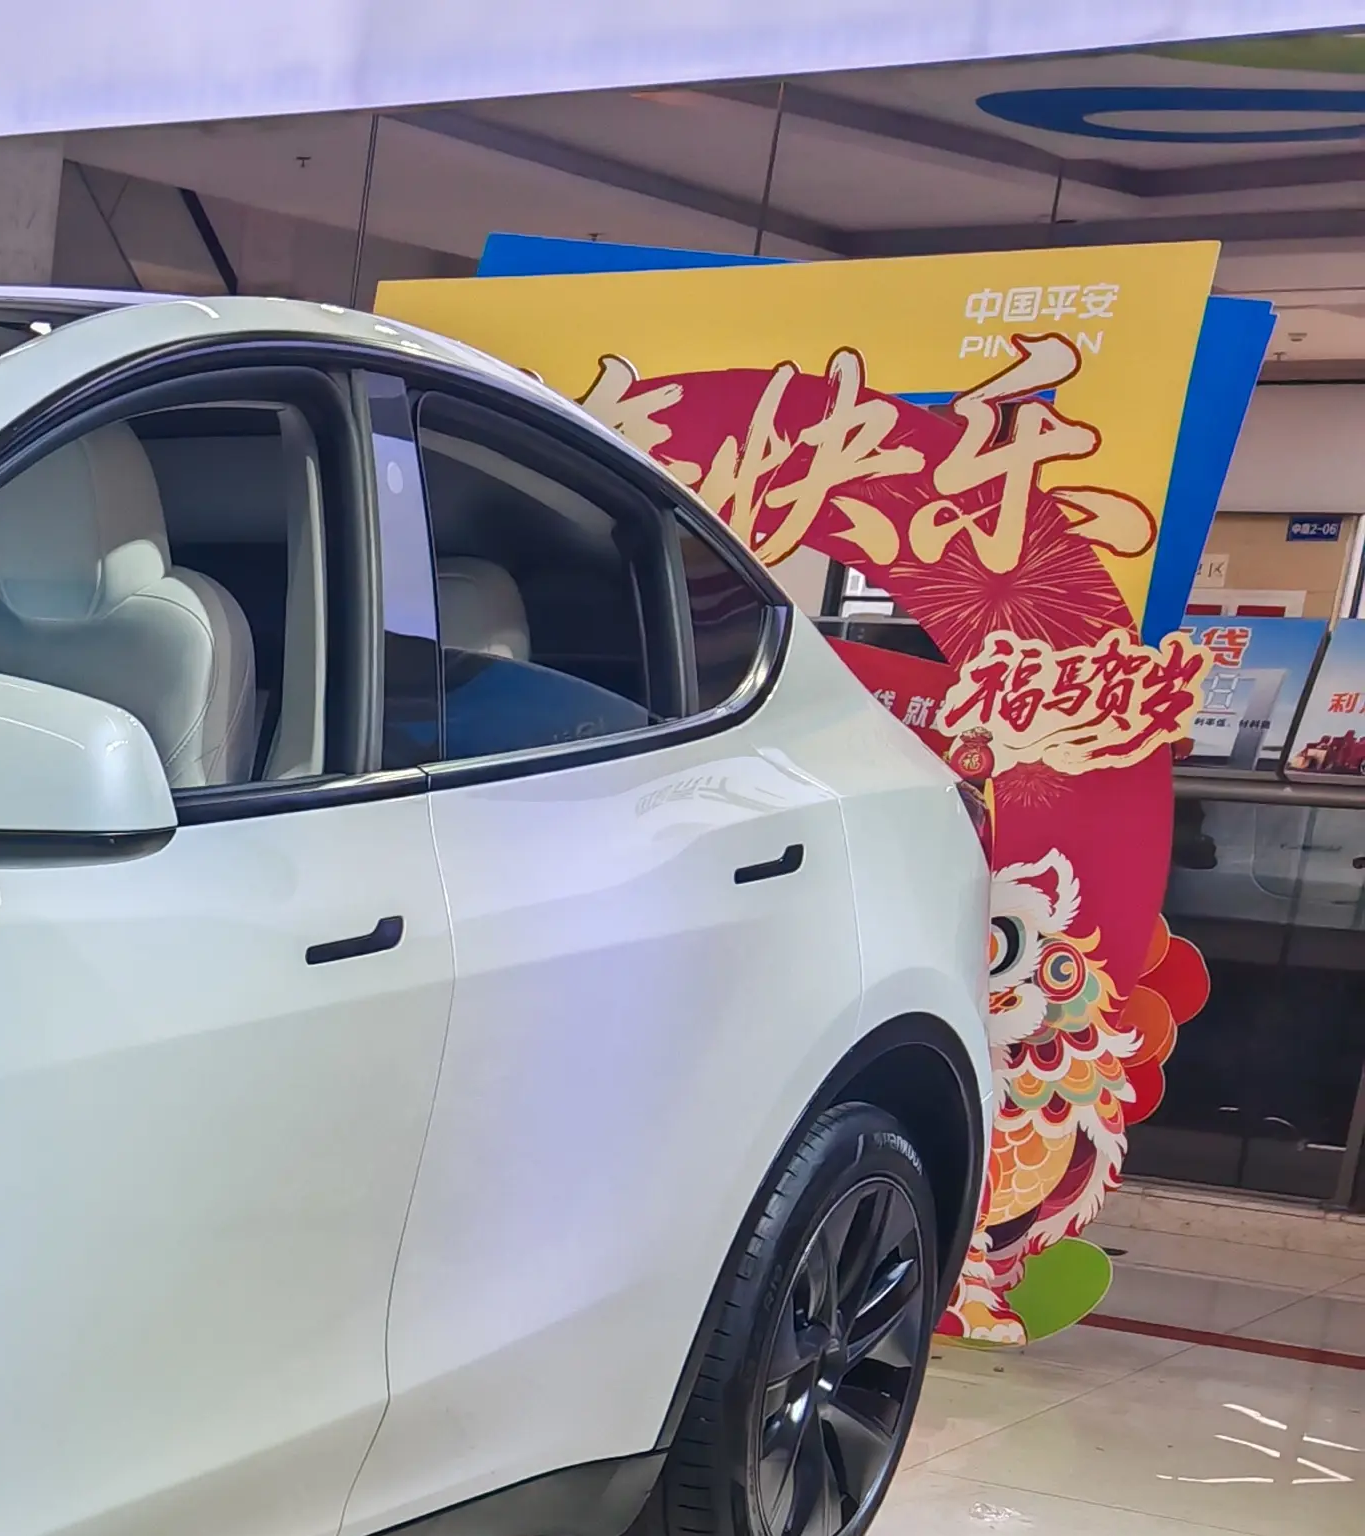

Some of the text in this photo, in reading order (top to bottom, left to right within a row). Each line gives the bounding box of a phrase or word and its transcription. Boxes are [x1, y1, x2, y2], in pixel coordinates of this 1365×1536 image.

[965, 283, 1121, 325] 中国平安
[1180, 626, 1252, 668] 贷
[1328, 692, 1365, 715] 利
